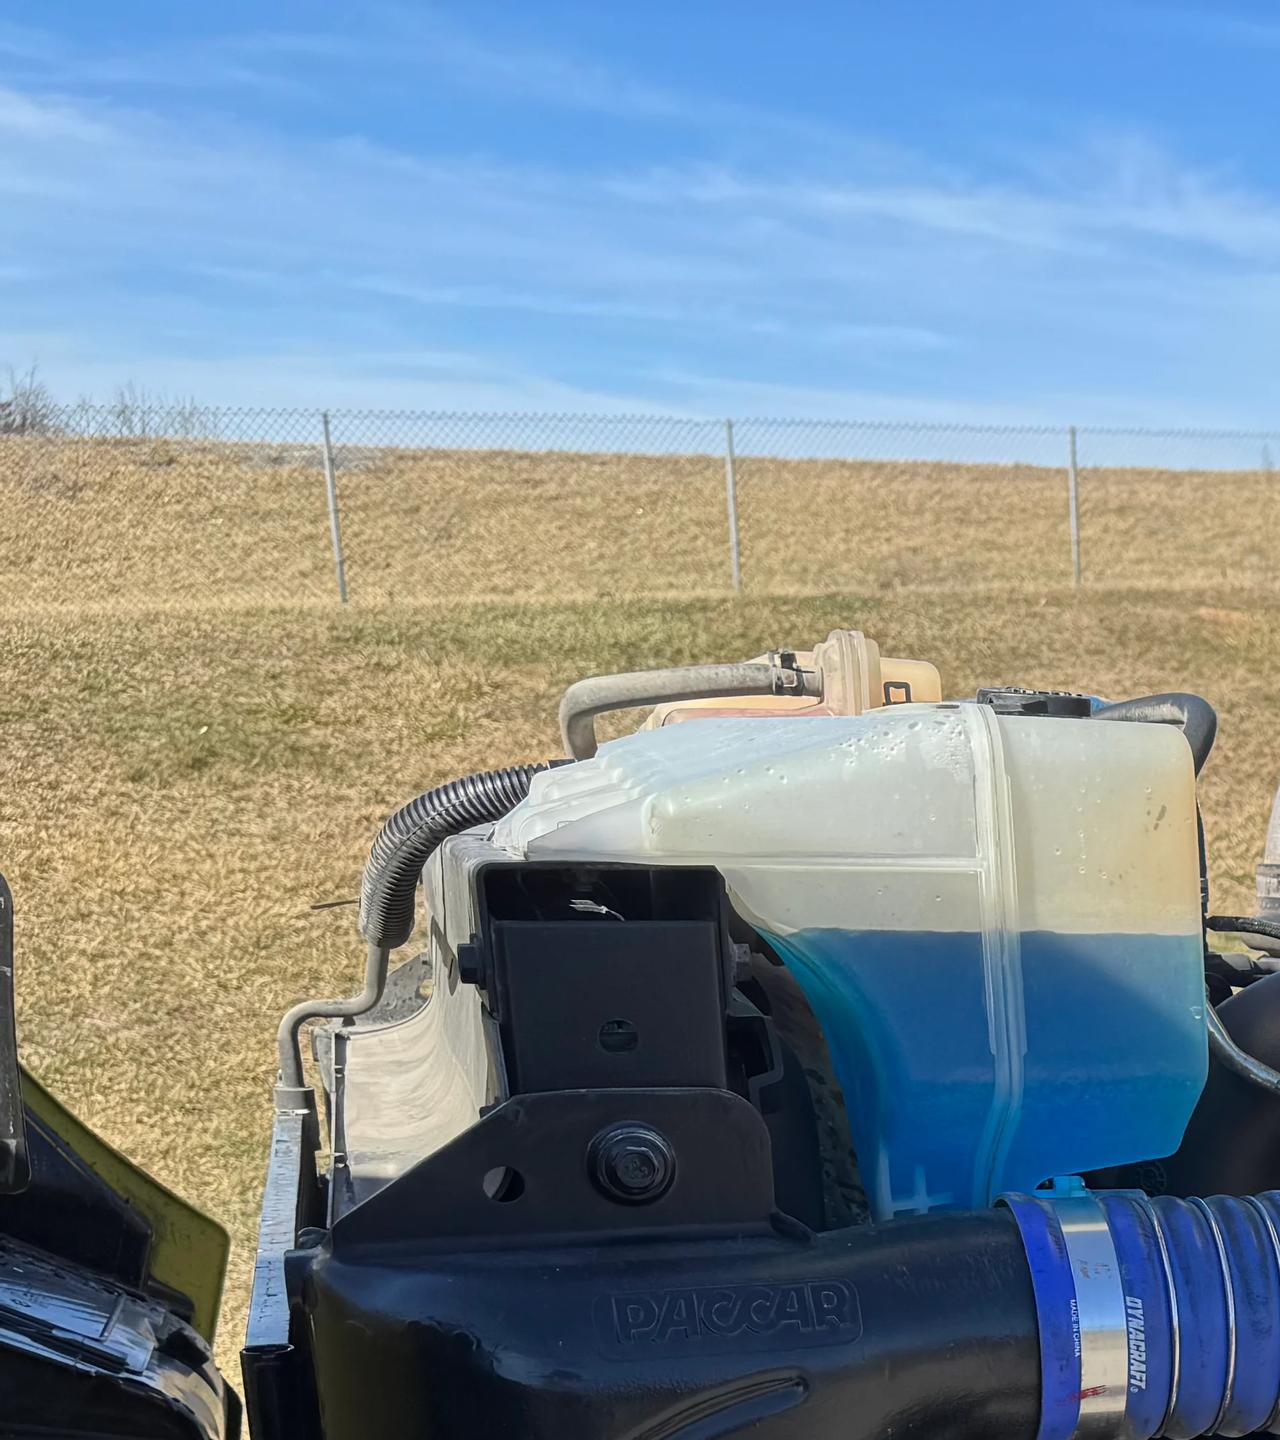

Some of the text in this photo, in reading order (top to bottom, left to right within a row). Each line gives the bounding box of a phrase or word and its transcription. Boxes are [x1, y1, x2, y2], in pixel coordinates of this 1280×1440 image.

[612, 1281, 850, 1344] PACCAR
[1070, 1300, 1080, 1322] MADE
[1072, 1324, 1080, 1332] IN
[1126, 1296, 1146, 1390] DYNACRAFT
